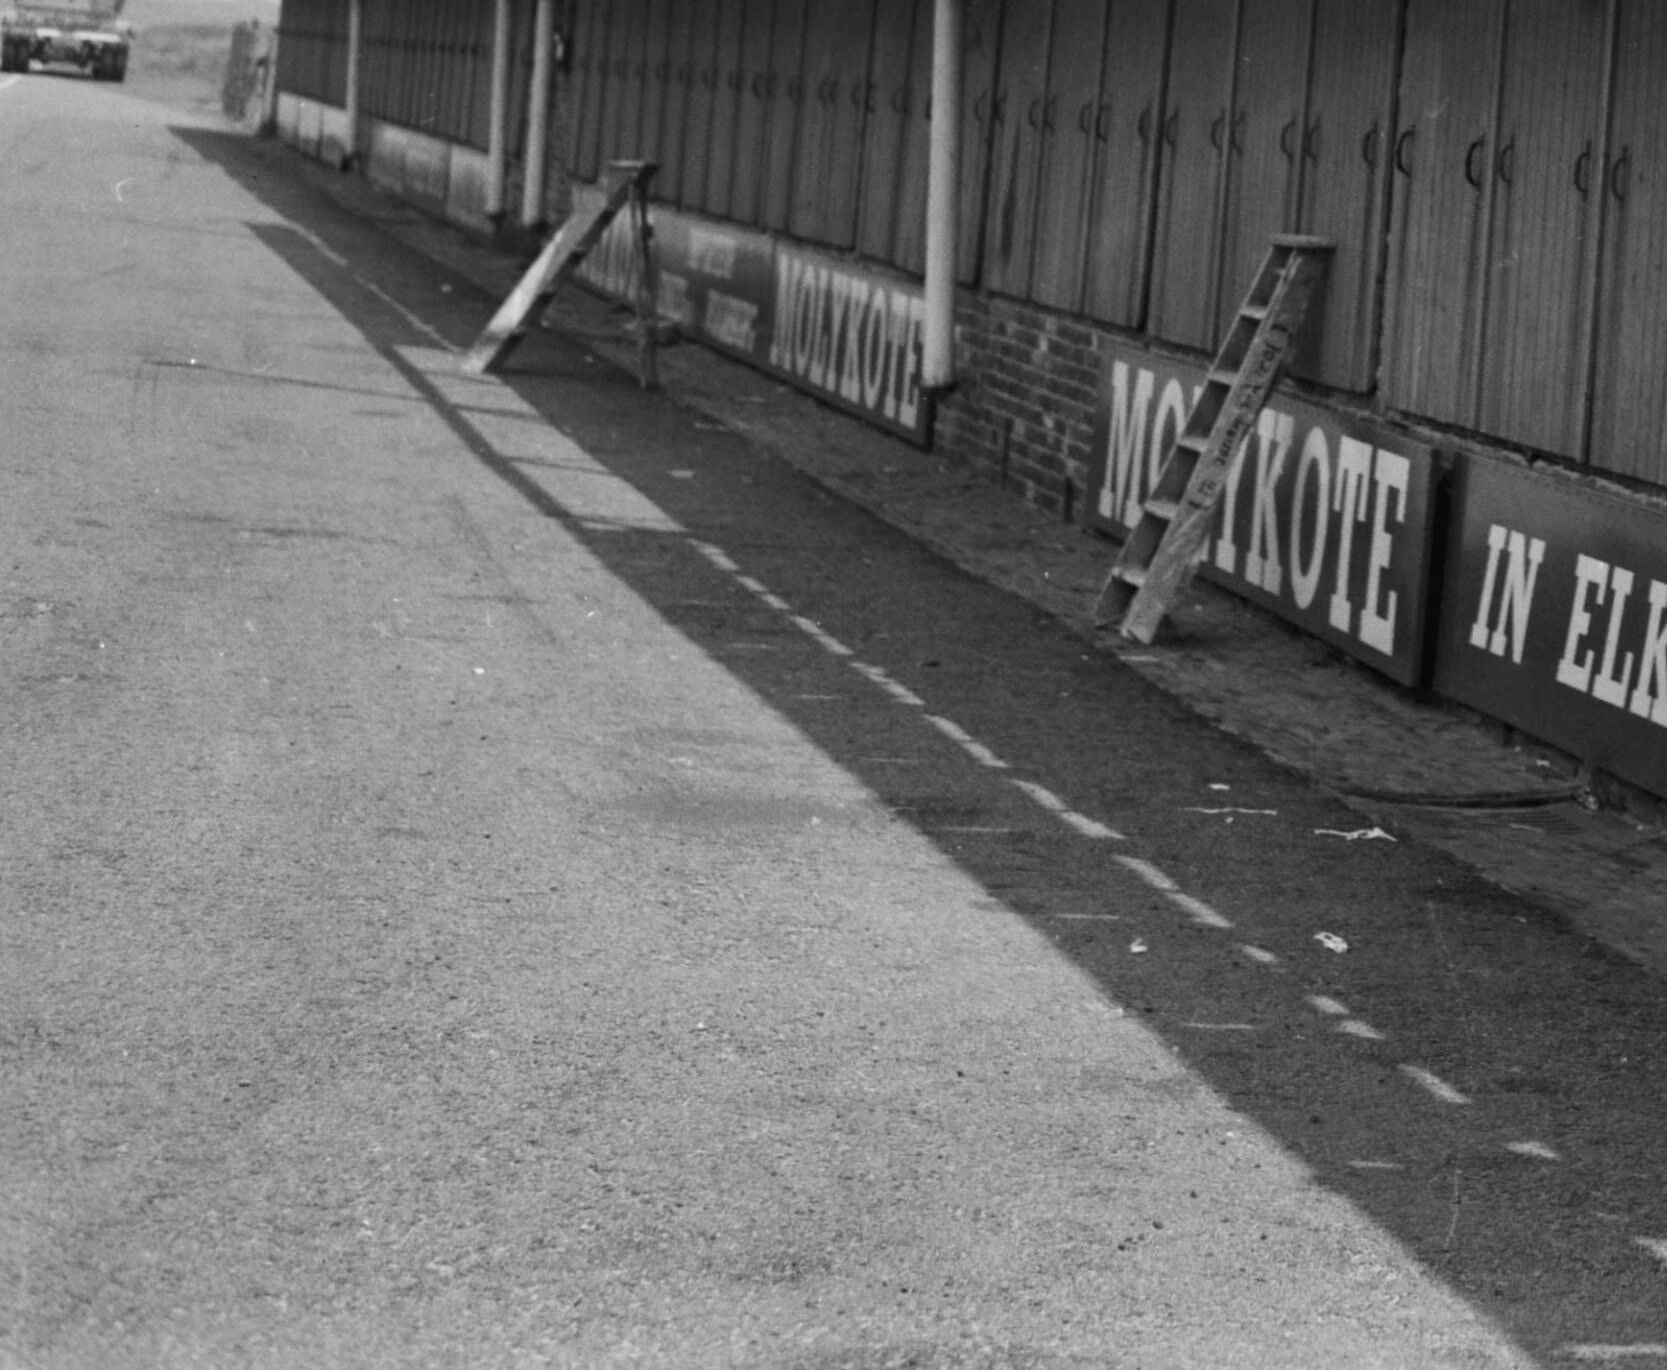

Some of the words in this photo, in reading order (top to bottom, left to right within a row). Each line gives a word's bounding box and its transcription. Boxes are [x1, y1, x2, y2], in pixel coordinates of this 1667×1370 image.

[769, 253, 926, 427] MOLYKOTE
[1098, 359, 1410, 657] MOYKOTE
[1469, 522, 1546, 665] IN
